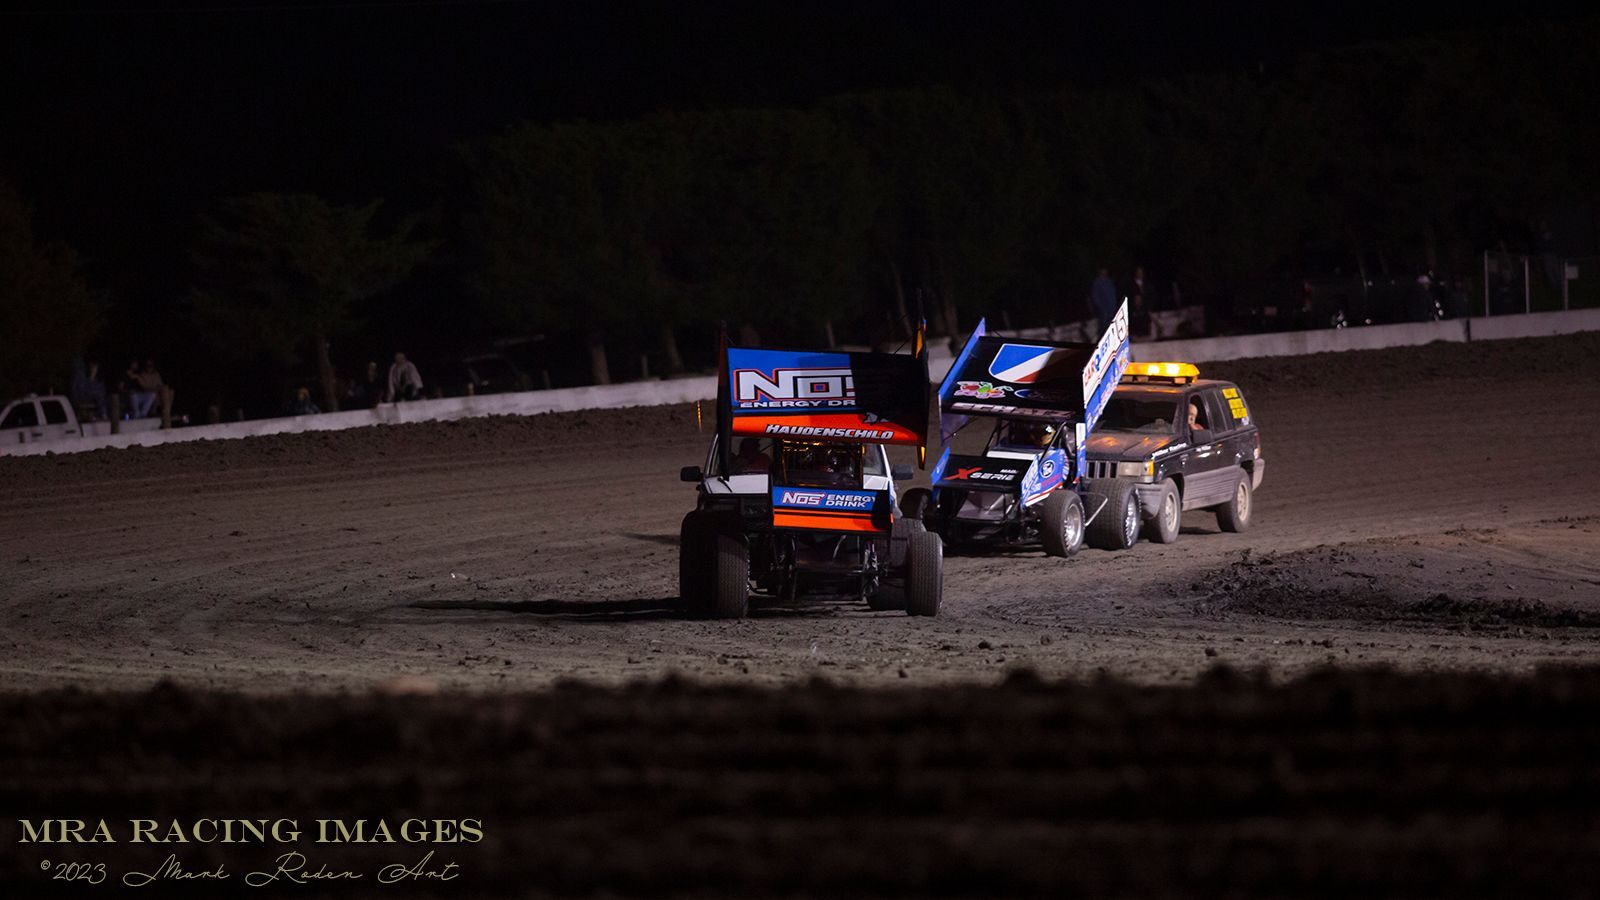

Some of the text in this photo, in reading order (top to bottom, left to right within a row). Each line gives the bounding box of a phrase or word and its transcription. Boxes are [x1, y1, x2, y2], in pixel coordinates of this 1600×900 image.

[735, 369, 856, 401] NO
[766, 424, 894, 440] HAUDENSCHILD
[969, 472, 1015, 480] SERIE
[781, 491, 825, 505] NOS
